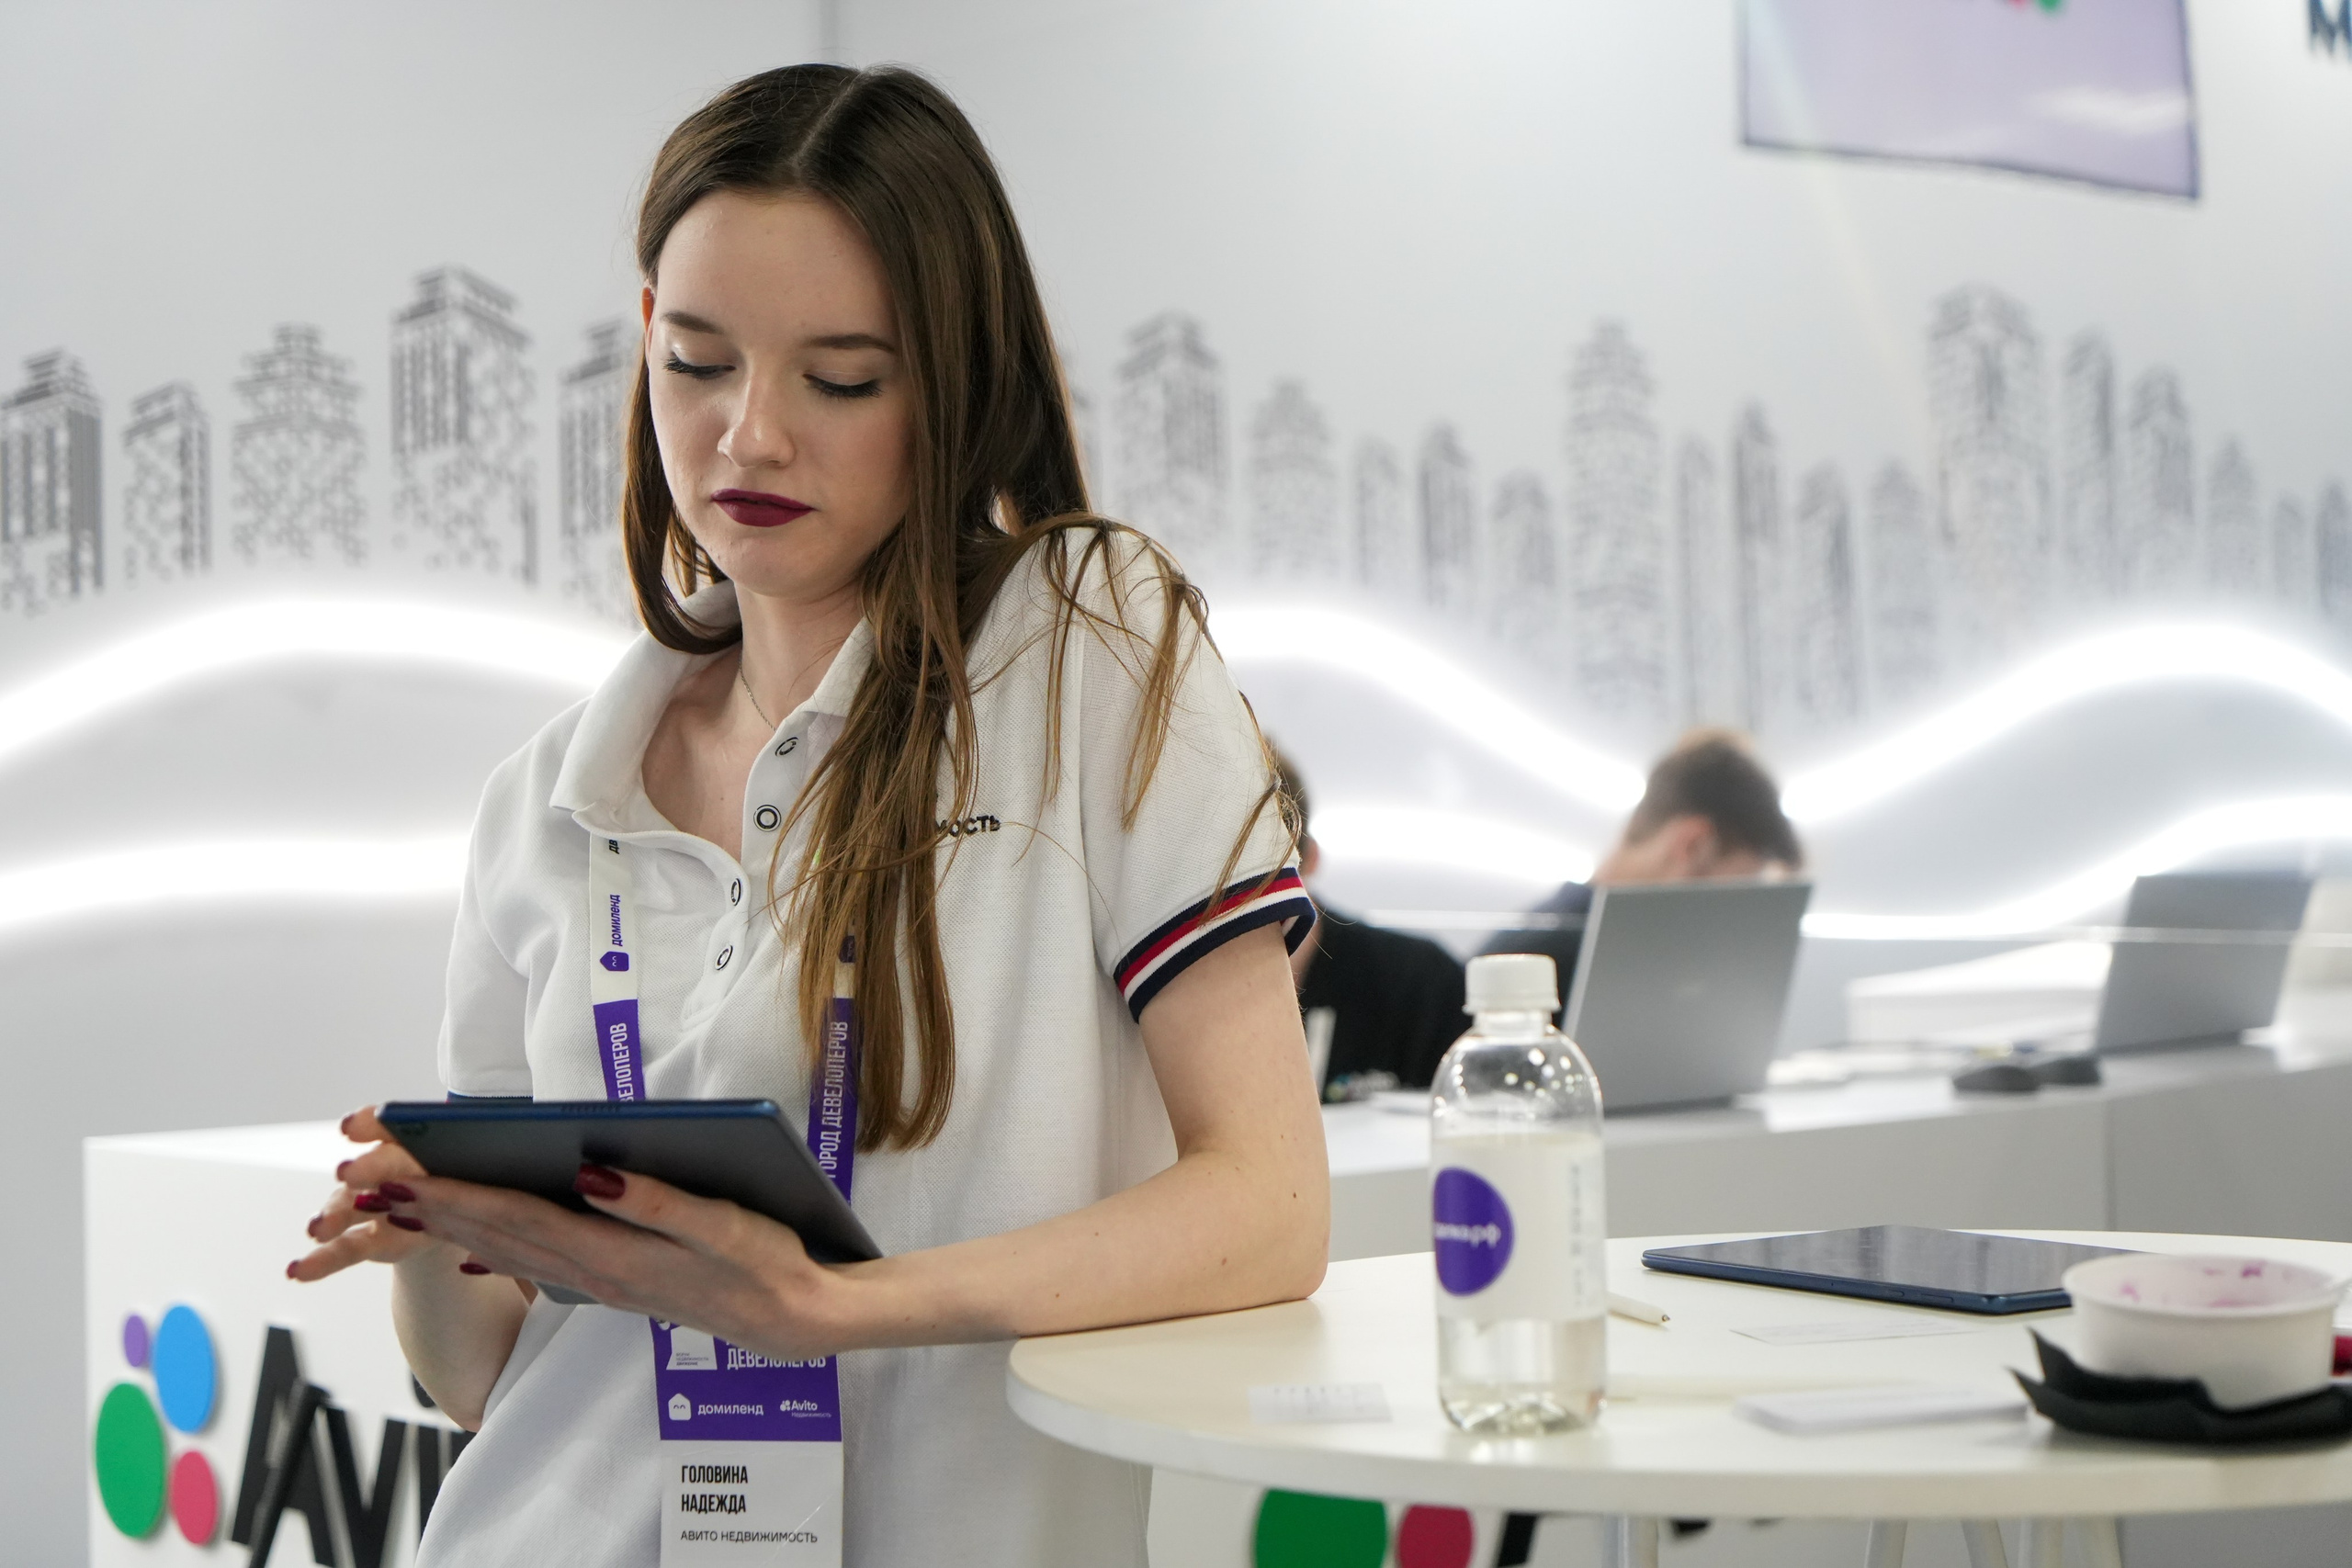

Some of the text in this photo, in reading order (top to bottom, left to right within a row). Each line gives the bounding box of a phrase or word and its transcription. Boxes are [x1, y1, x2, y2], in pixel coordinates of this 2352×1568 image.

[791, 1399, 818, 1411] Avito
[681, 1464, 749, 1484] ГОЛОВИНА
[681, 1494, 747, 1514] НАДЕЖДА
[680, 1530, 819, 1544] АВИТО НЕДВИЖИМОСТЬ
